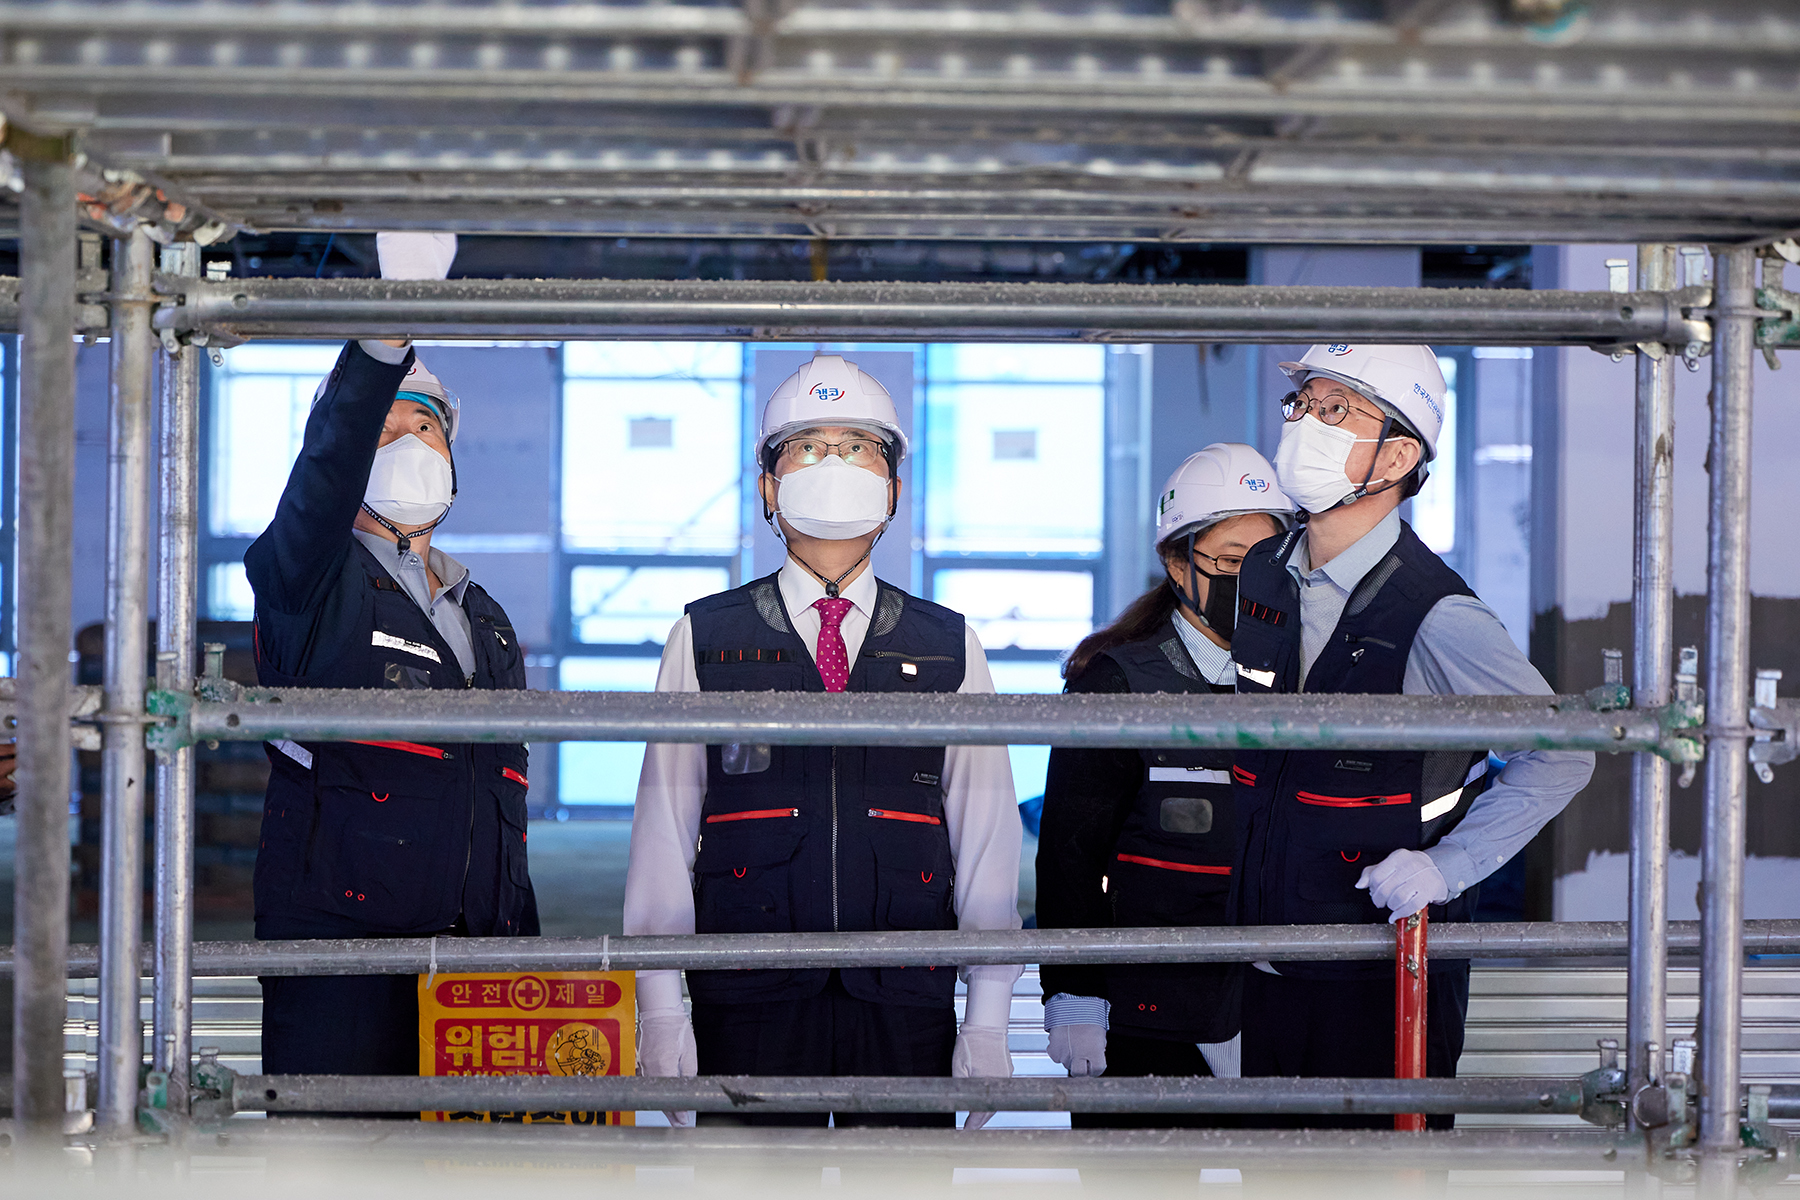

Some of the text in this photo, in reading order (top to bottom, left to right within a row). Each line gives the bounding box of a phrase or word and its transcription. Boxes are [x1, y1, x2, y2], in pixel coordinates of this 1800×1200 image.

[451, 983, 605, 1004] 안전 제일
[445, 1024, 540, 1068] 위험!
